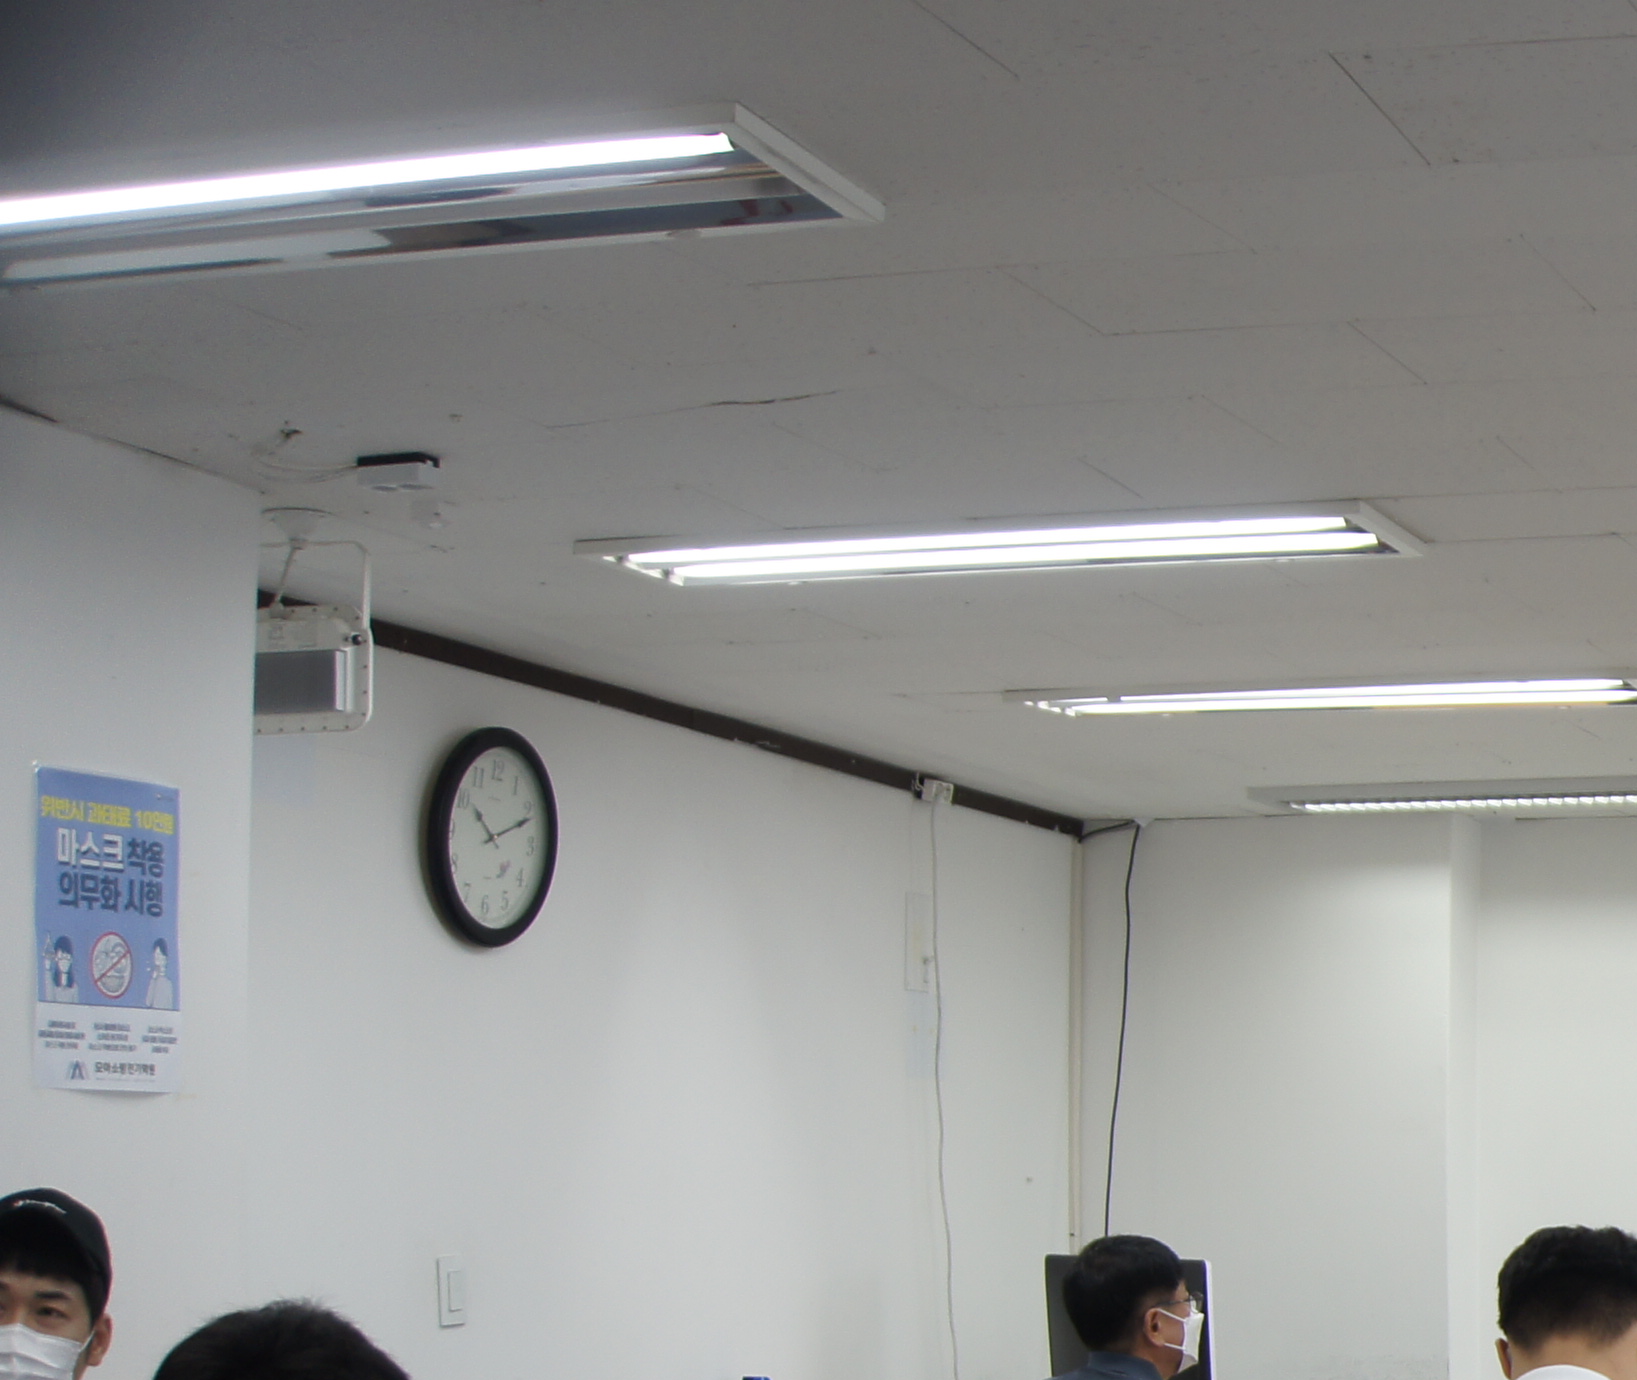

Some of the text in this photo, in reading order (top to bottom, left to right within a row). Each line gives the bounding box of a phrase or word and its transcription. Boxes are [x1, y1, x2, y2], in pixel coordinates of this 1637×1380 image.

[473, 766, 484, 788] 11
[491, 760, 504, 781] 12
[57, 827, 164, 880] 마스크 착용
[58, 870, 163, 918] 의무화 시행
